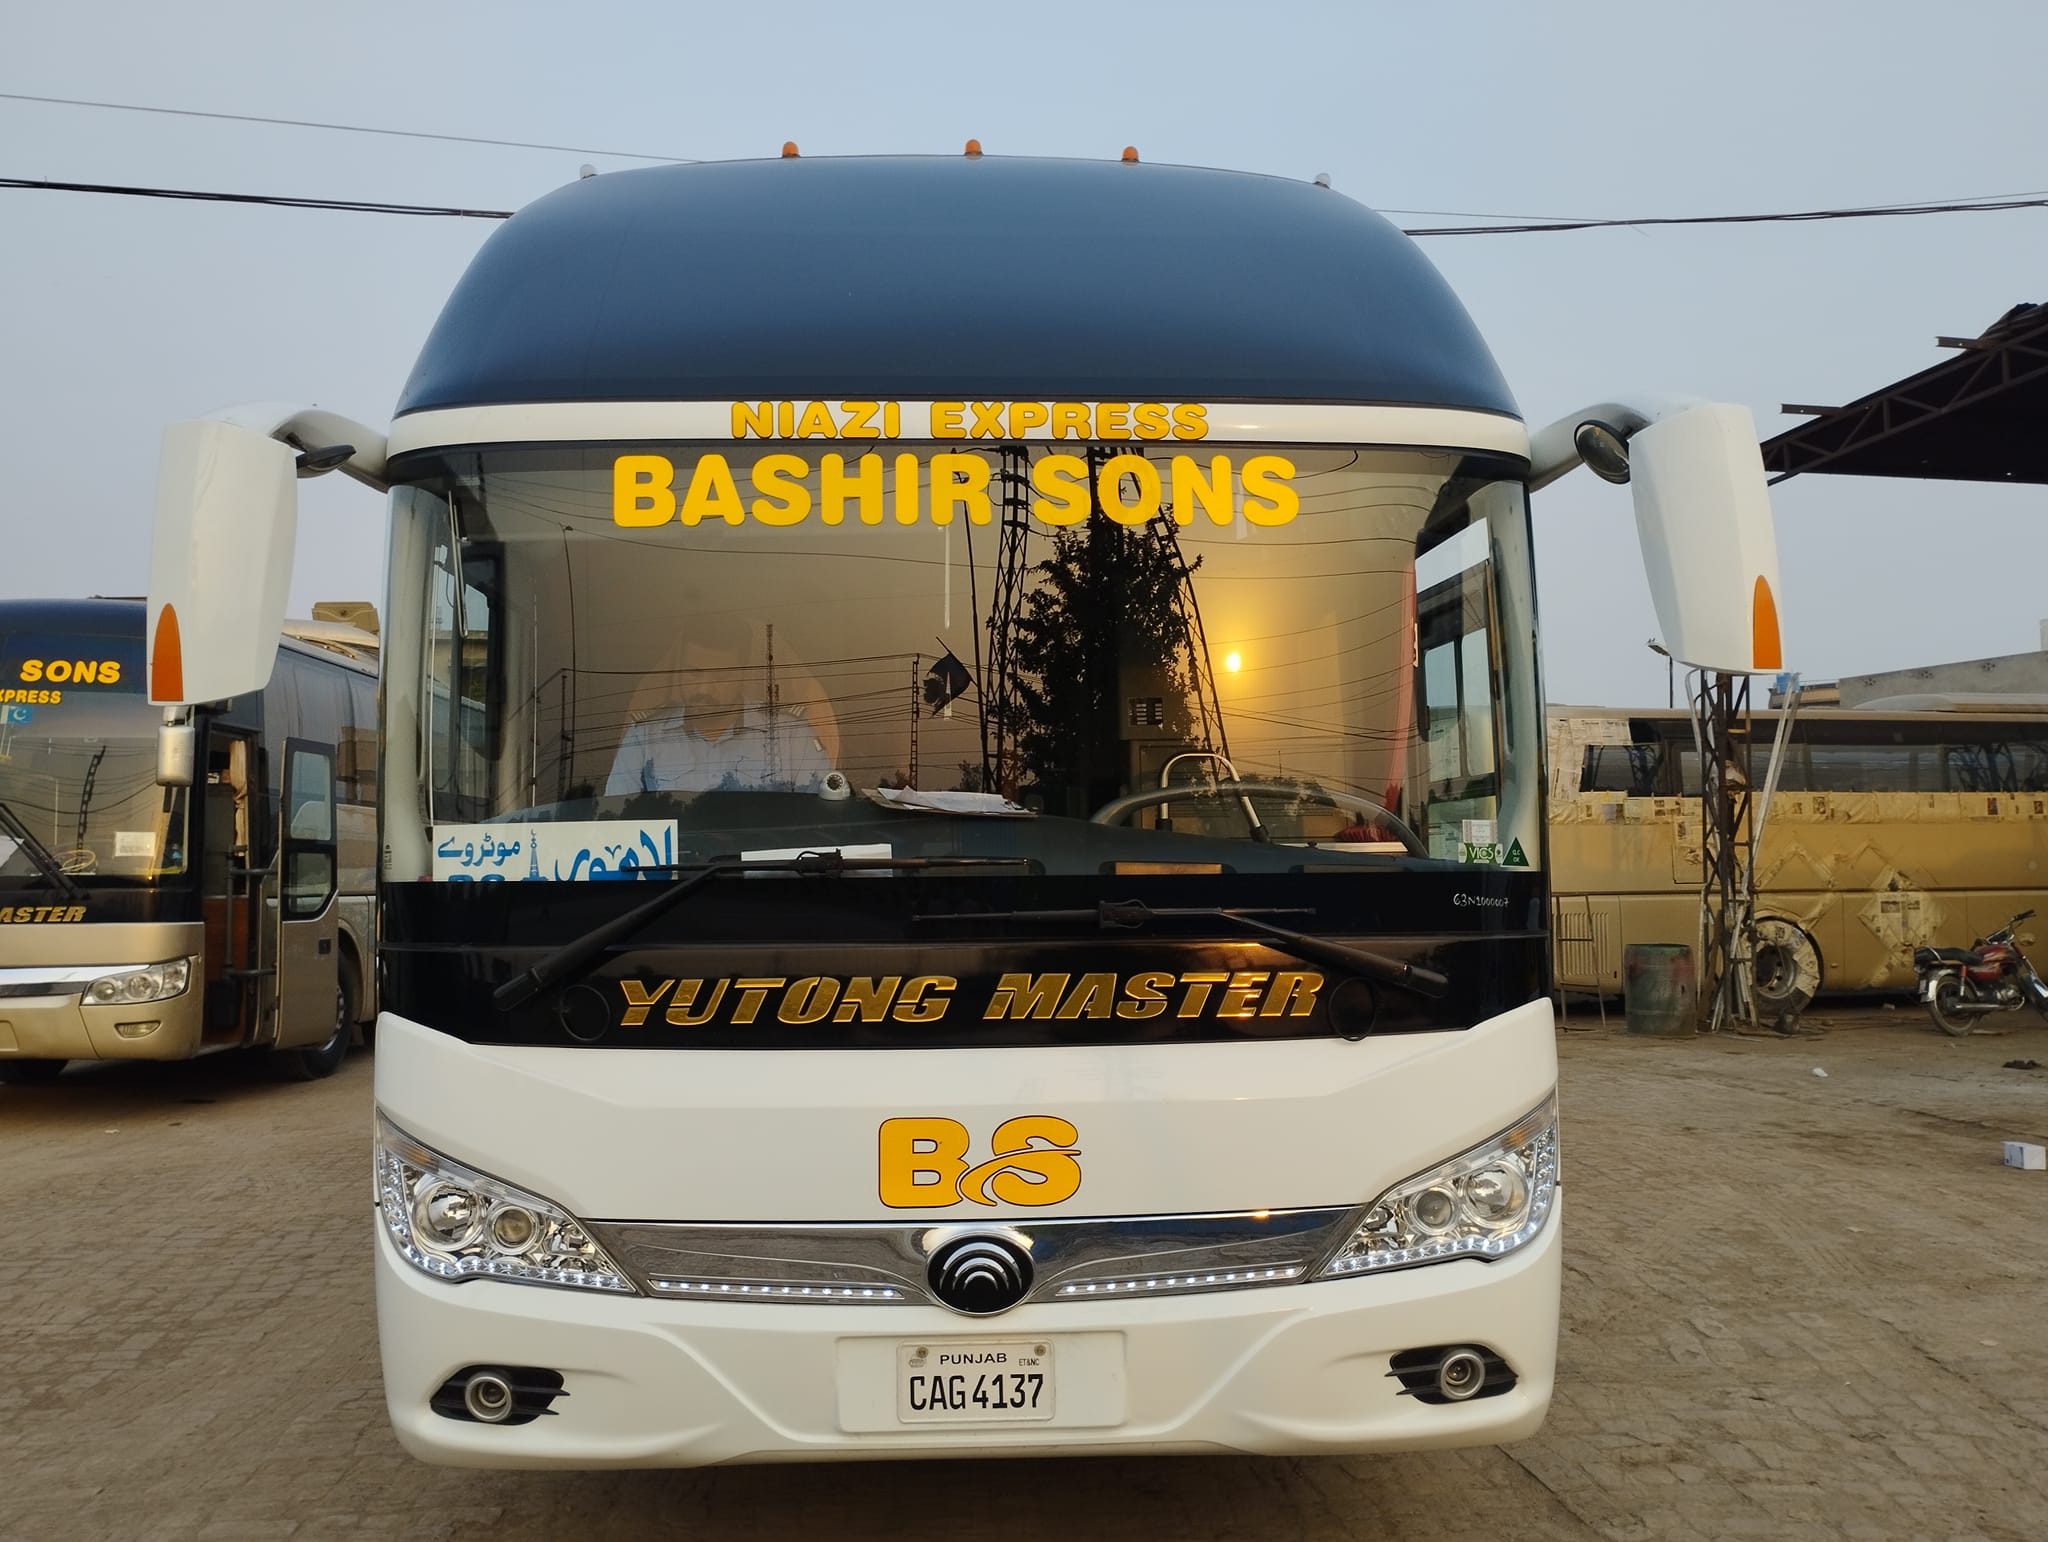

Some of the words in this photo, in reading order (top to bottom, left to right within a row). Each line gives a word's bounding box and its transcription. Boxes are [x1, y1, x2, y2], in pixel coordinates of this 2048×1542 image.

[731, 401, 901, 439] NIAZI
[930, 401, 1209, 440] EXPRESS
[612, 453, 992, 528] BASHIR
[1032, 453, 1300, 527] SONS
[20, 659, 121, 684] SONS
[437, 832, 521, 867] موٹروے
[620, 976, 958, 1026] YUTONG
[982, 972, 1325, 1020] MASTER
[940, 1353, 1007, 1365] PUNJAB
[909, 1375, 966, 1411] CAG
[972, 1373, 1043, 1409] 4137
